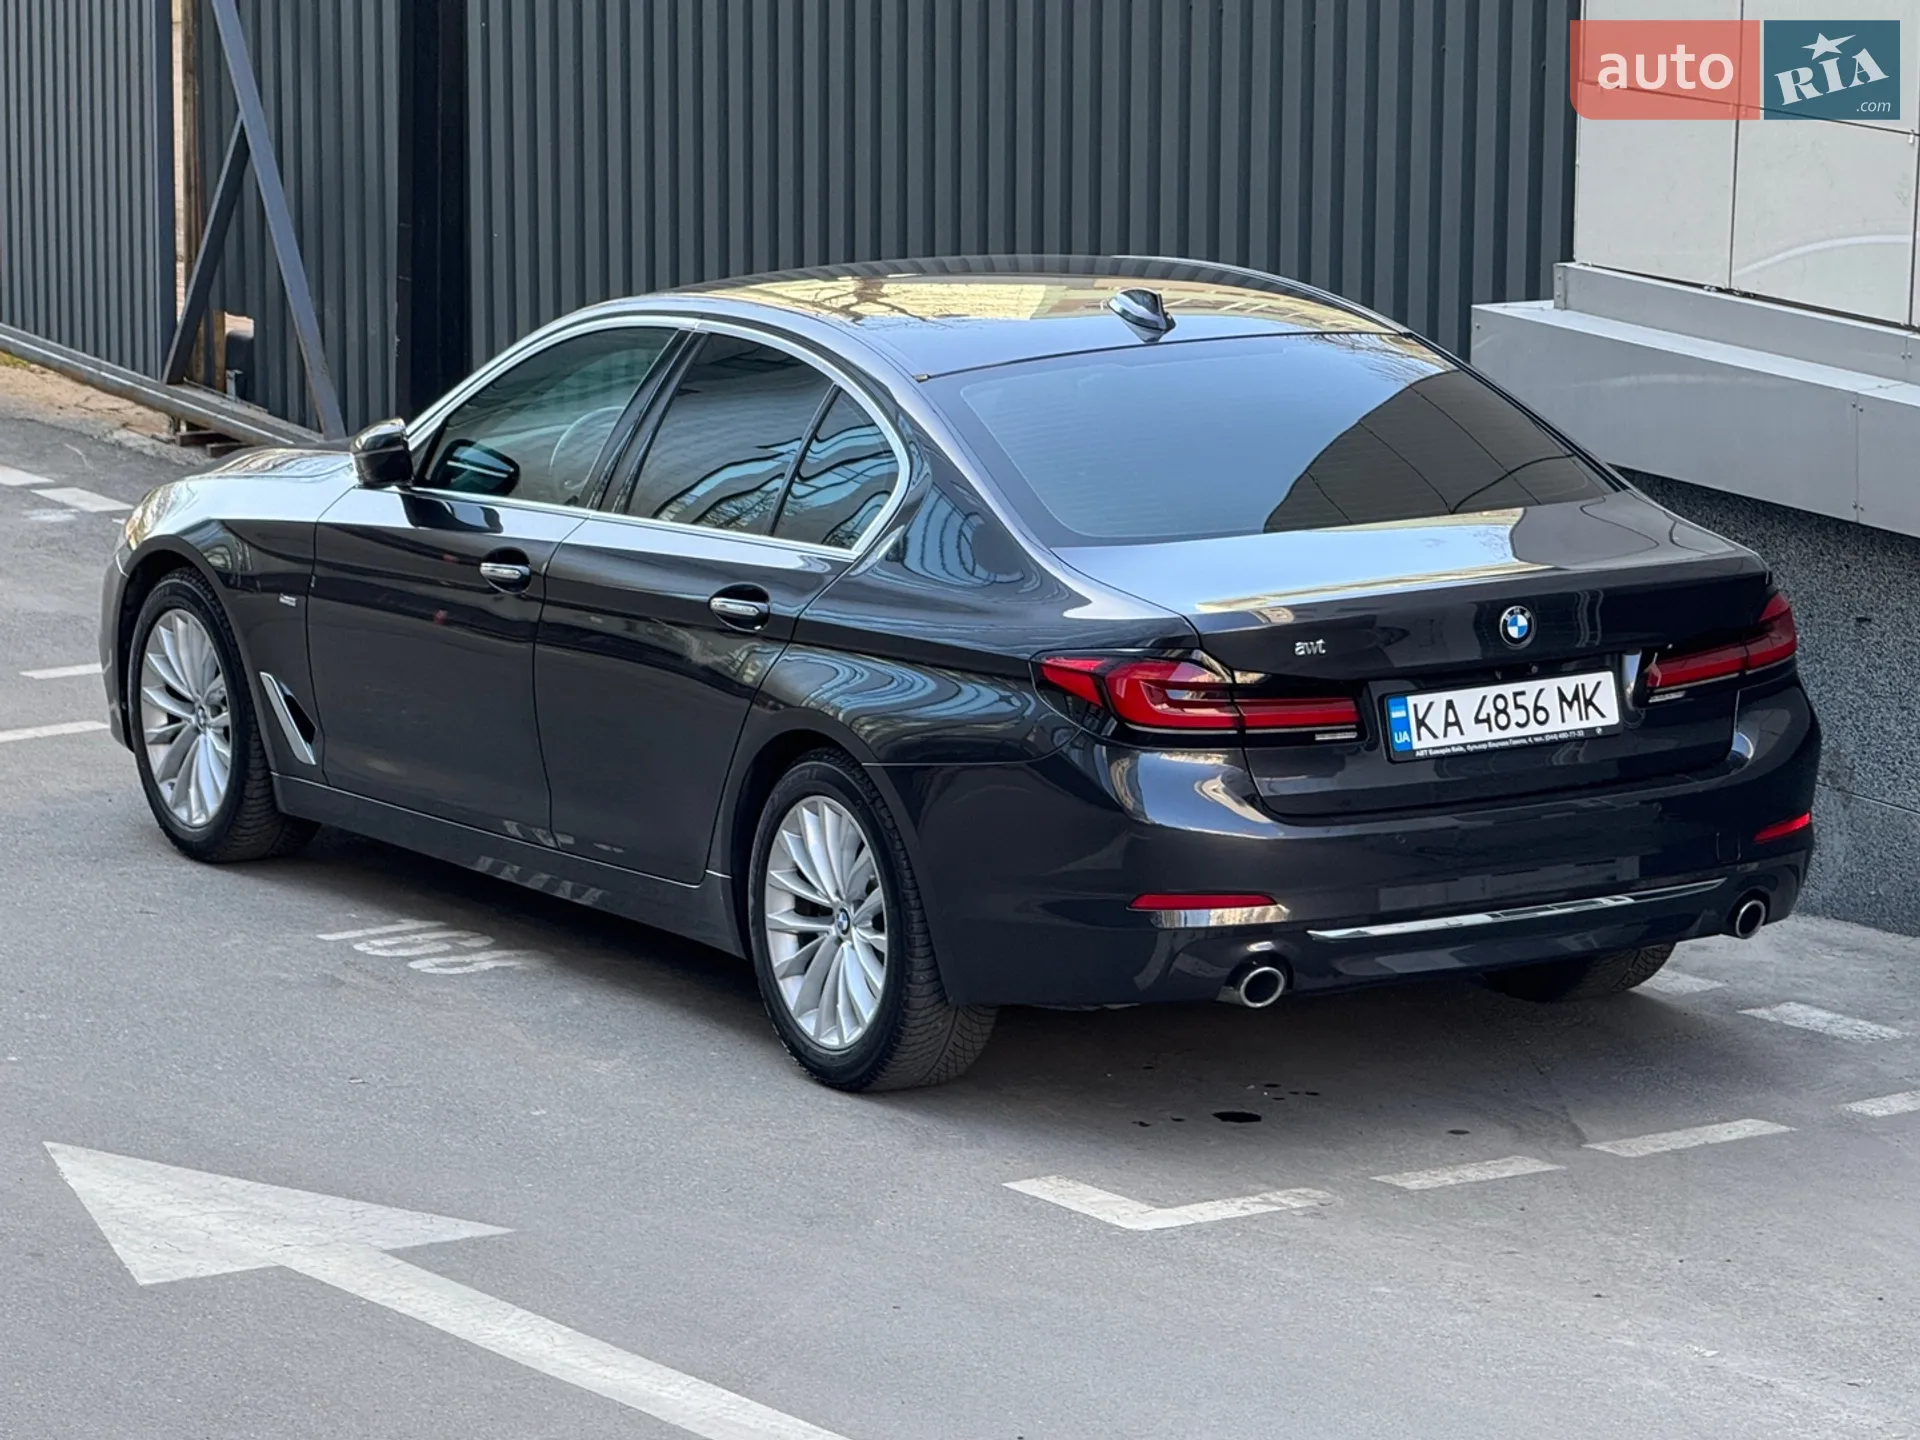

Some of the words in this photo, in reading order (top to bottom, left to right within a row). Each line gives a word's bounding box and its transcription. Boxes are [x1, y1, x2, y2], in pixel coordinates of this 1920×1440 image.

[1294, 638, 1326, 656] awt
[1473, 688, 1550, 733] 4856
[1395, 731, 1410, 743] UA
